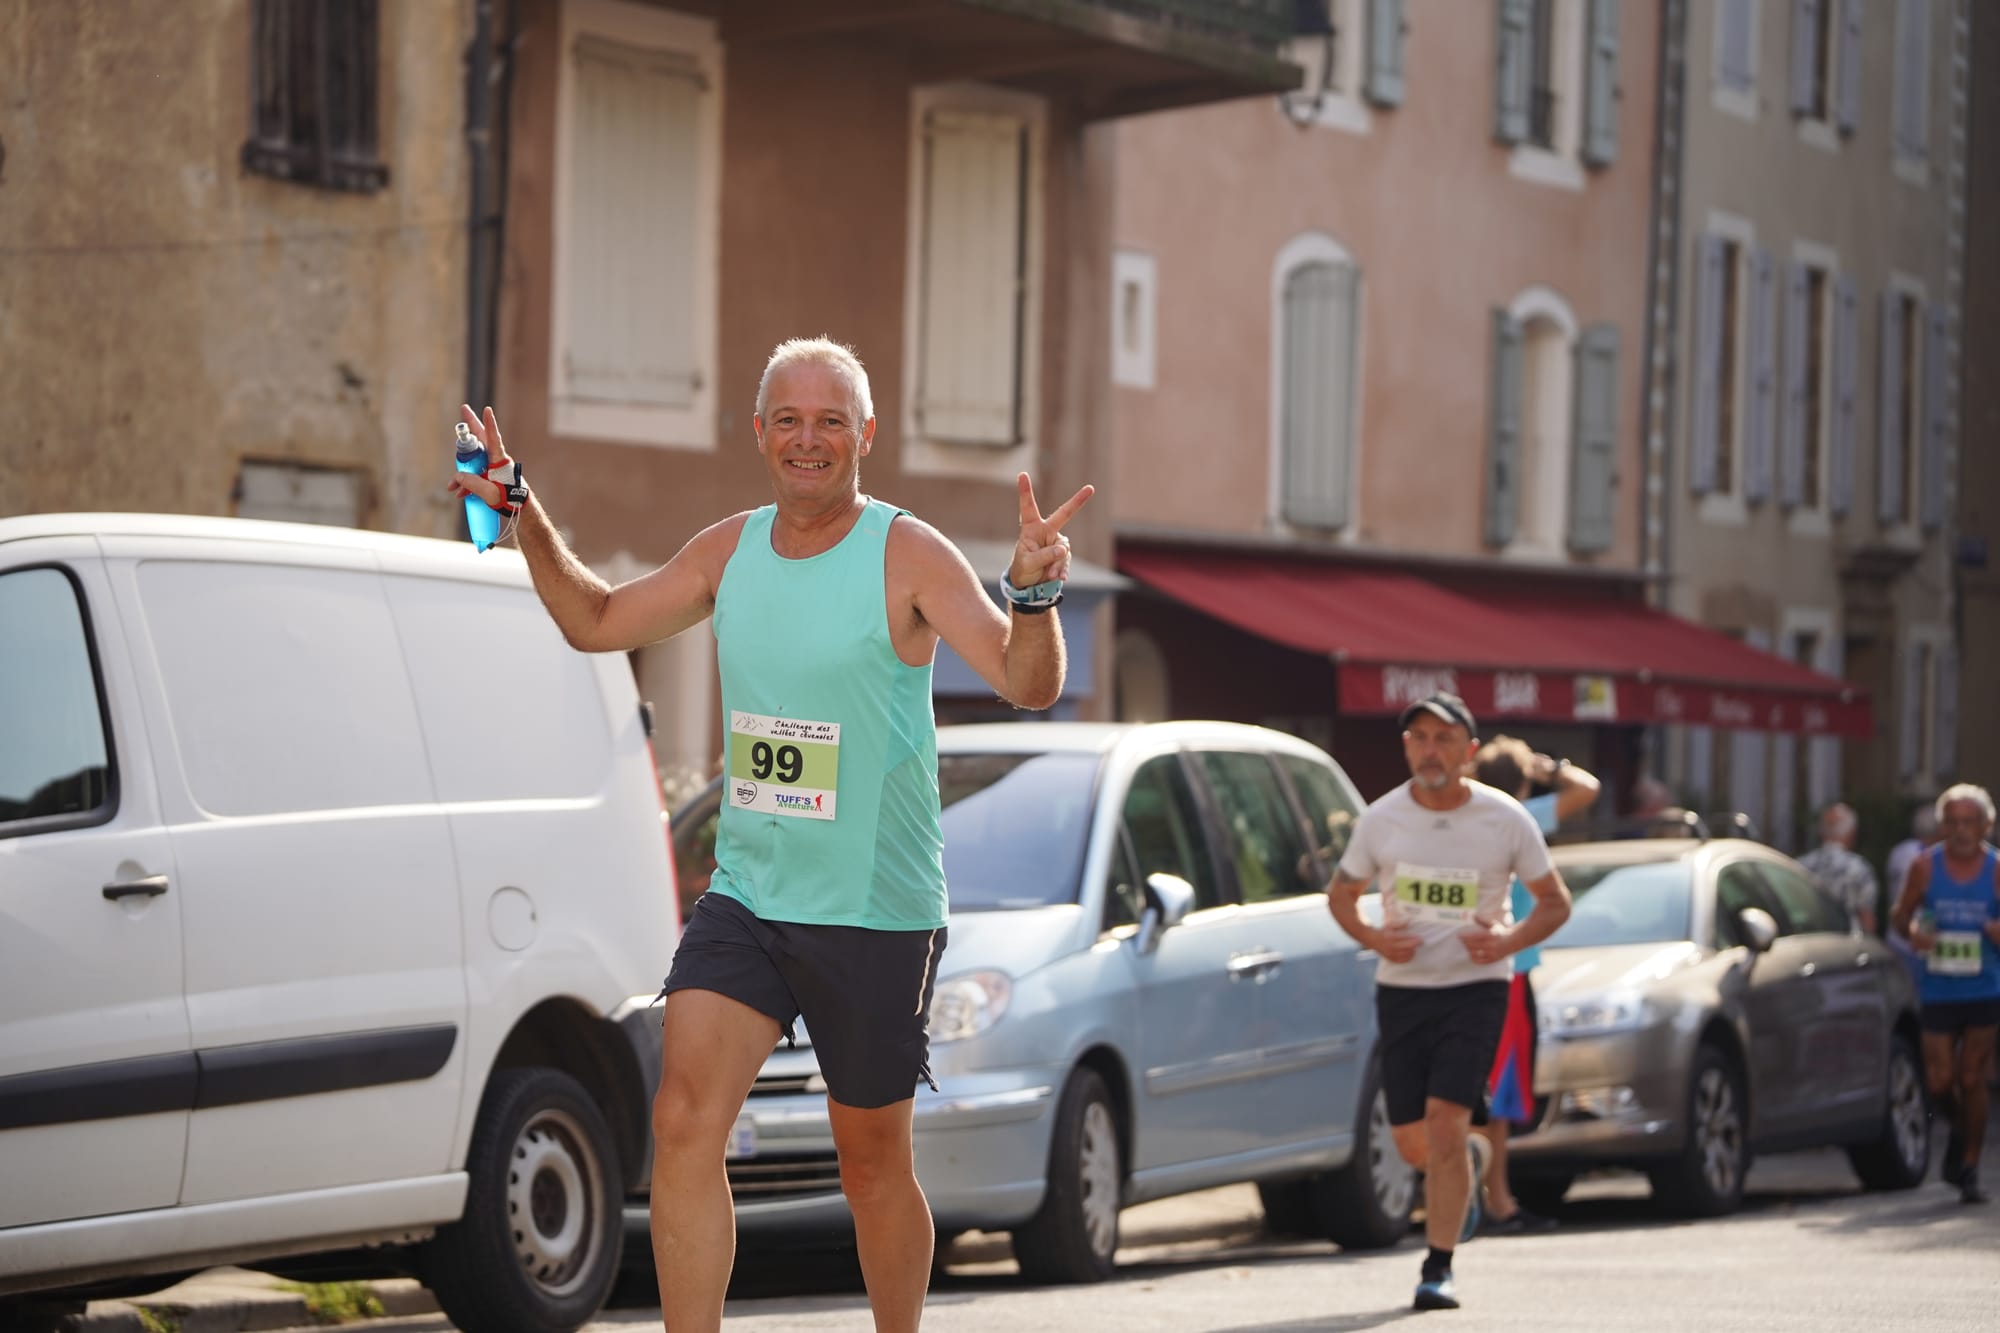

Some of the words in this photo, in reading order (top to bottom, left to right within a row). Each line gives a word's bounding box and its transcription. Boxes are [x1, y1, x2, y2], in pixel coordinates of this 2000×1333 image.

[1494, 671, 1539, 711] BAR
[775, 720, 812, 732] Challenge
[770, 729, 796, 737] vallées
[800, 731, 834, 741] cévenoles
[752, 741, 803, 783] 99
[775, 794, 811, 805] TUFF'S
[777, 801, 815, 811] Aventure
[1408, 881, 1465, 906] 188
